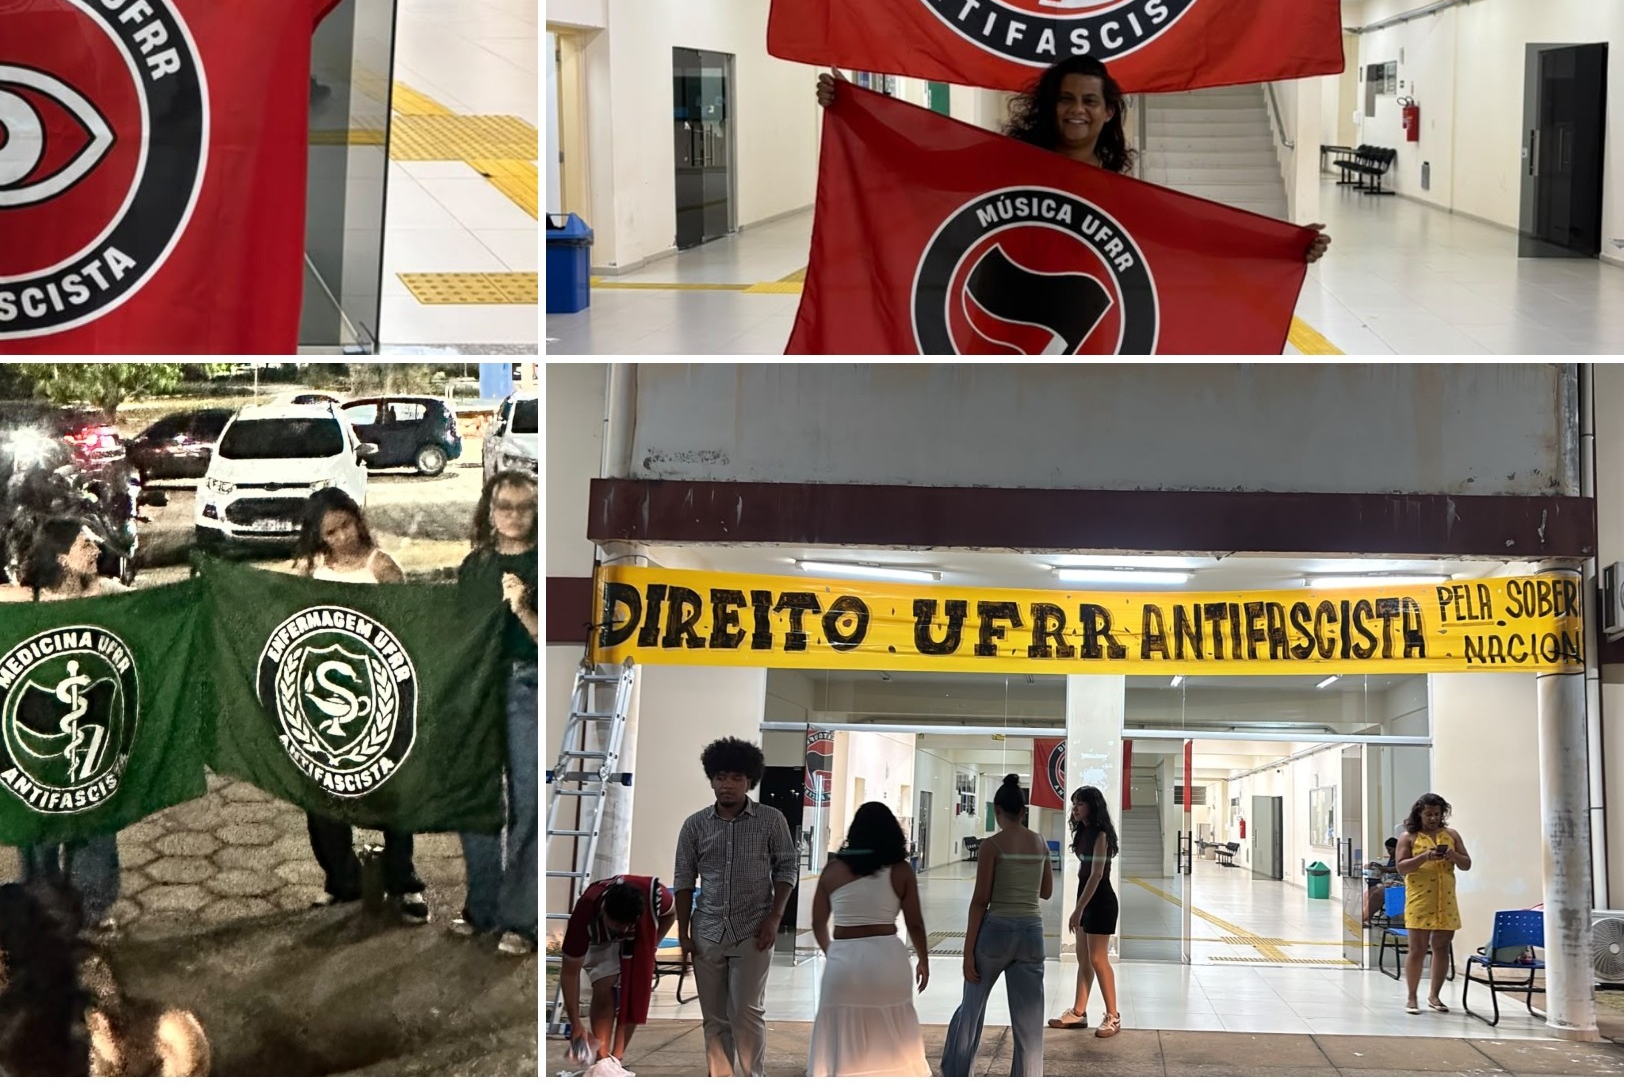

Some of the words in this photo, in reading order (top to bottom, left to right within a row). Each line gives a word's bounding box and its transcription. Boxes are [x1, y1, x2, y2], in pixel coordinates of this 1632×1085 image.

[975, 195, 1073, 228] MÚSICA
[1080, 214, 1134, 273] UFRR
[267, 611, 373, 663] ENFERMAGEM
[373, 631, 411, 683] UFRR
[599, 581, 872, 653] DIREITO
[913, 597, 1127, 661] UFRR
[1140, 598, 1427, 661] ANTIFASCISTA
[1436, 584, 1492, 622] PELA
[1464, 631, 1579, 664] NACION
[97, 635, 131, 674] UFRR
[0, 759, 125, 809] ANTIFASCIS
[279, 735, 395, 792] ANTIFASCISTA
